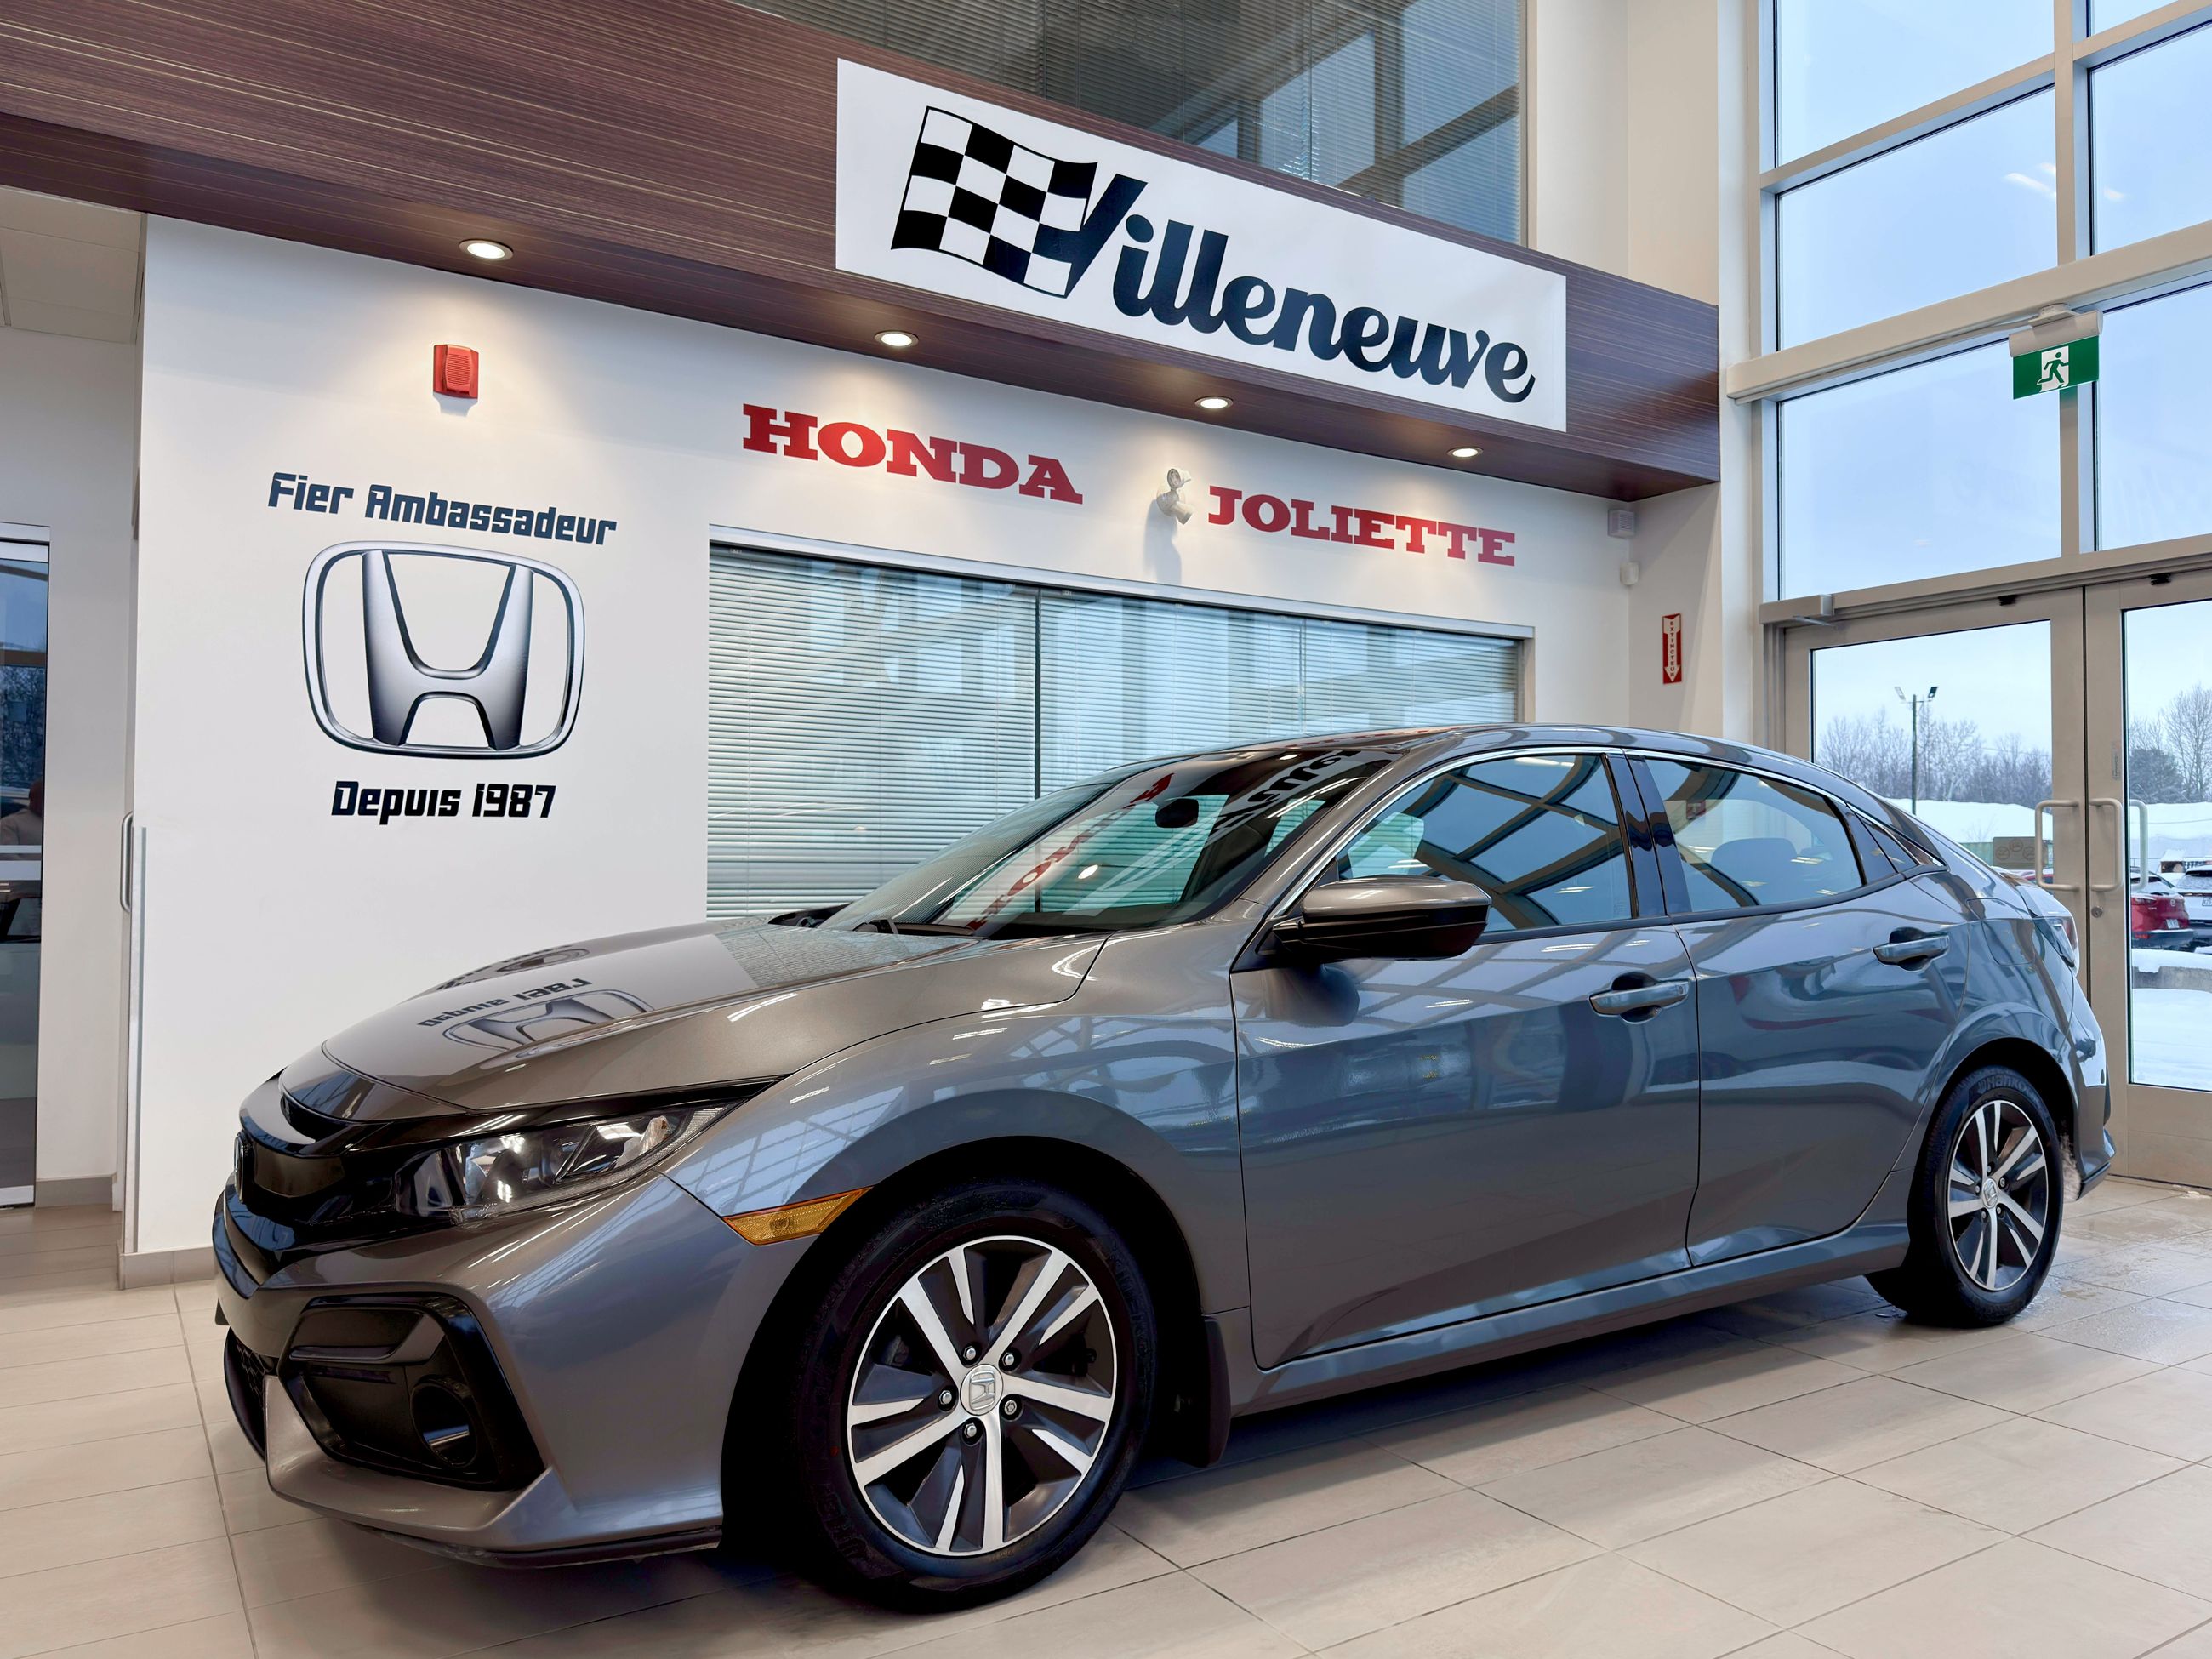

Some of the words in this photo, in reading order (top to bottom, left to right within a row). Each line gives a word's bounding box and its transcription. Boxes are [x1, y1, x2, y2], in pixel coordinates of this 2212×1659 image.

[1032, 173, 1536, 404] Villeneuve
[743, 404, 1083, 505] HONDA
[267, 472, 354, 514] Fier
[364, 484, 617, 545] Ambassadeur
[1208, 485, 1515, 566] JOLIETTE
[331, 780, 461, 825] Depuis
[471, 783, 556, 818] 1987
